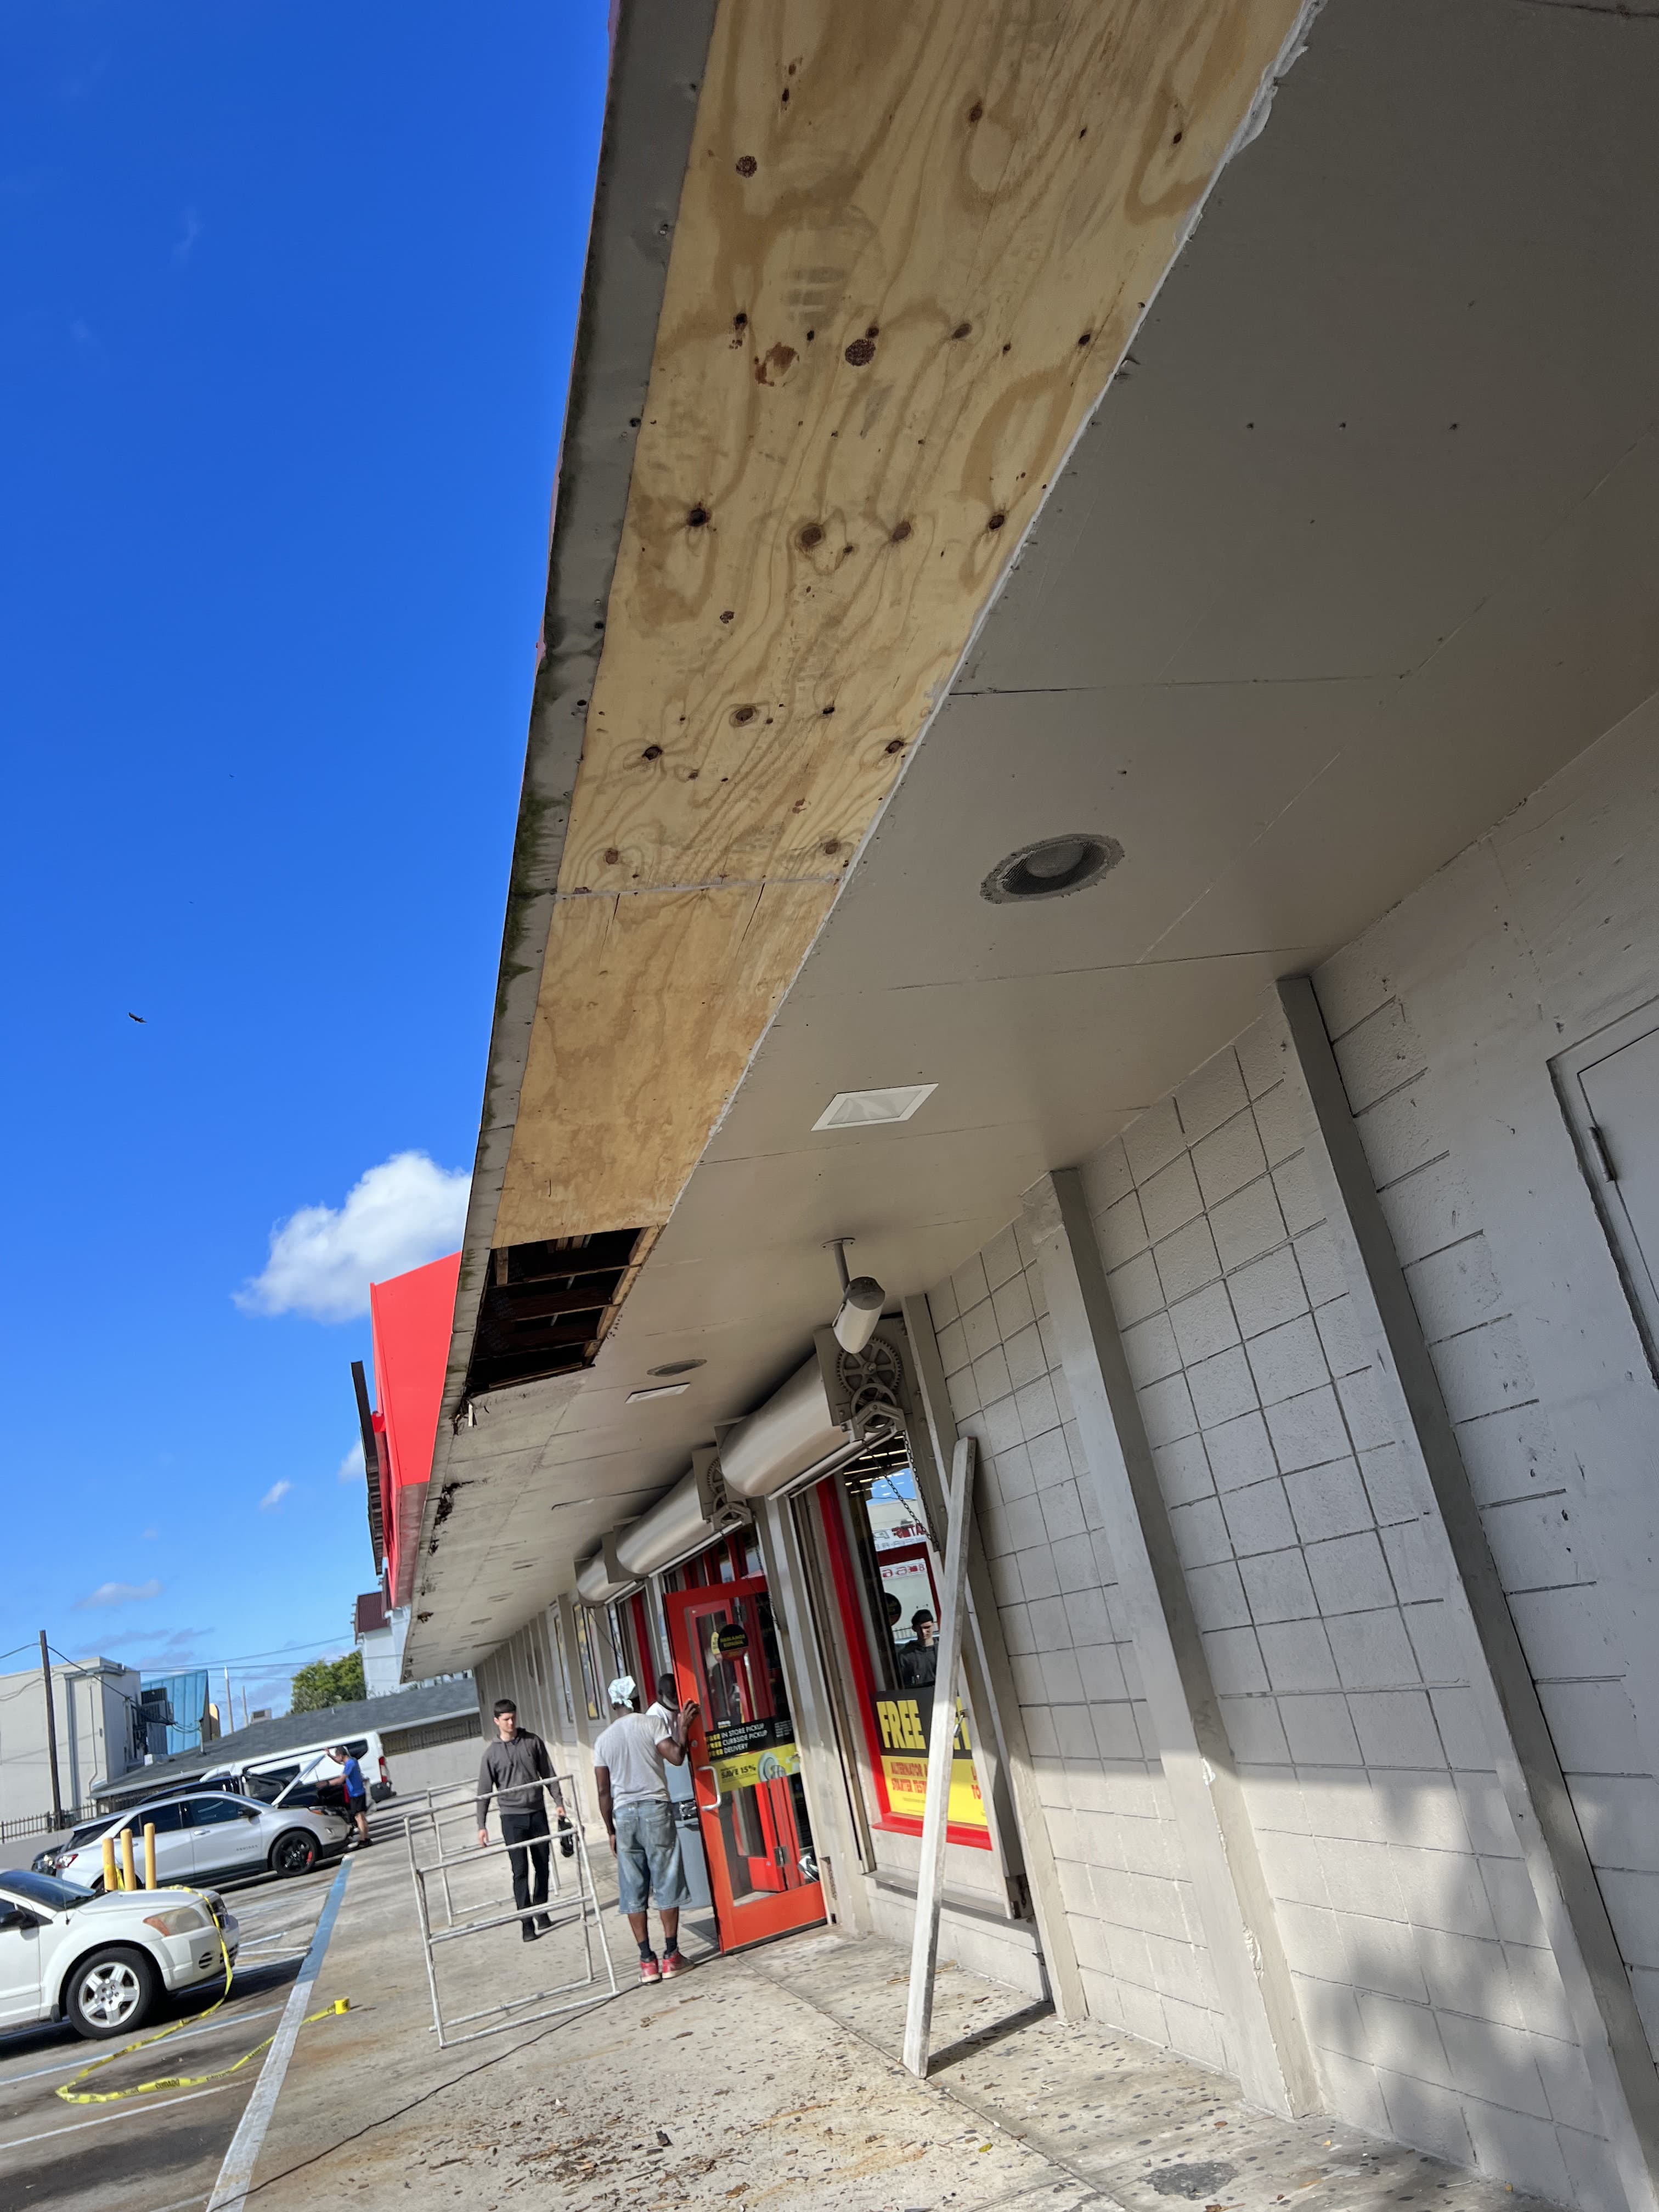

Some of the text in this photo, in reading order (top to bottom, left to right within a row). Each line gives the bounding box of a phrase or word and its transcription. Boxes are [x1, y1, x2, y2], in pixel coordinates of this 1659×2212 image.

[728, 1727, 746, 1736] STORE
[746, 1723, 765, 1733] PICKUP
[876, 1700, 927, 1750] FREE
[722, 1734, 749, 1747] CURBSIDE
[748, 1730, 768, 1740] PICKUP
[723, 1742, 748, 1754] DELIVERY
[721, 1767, 739, 1779] SAVE
[741, 1764, 757, 1775] 15%
